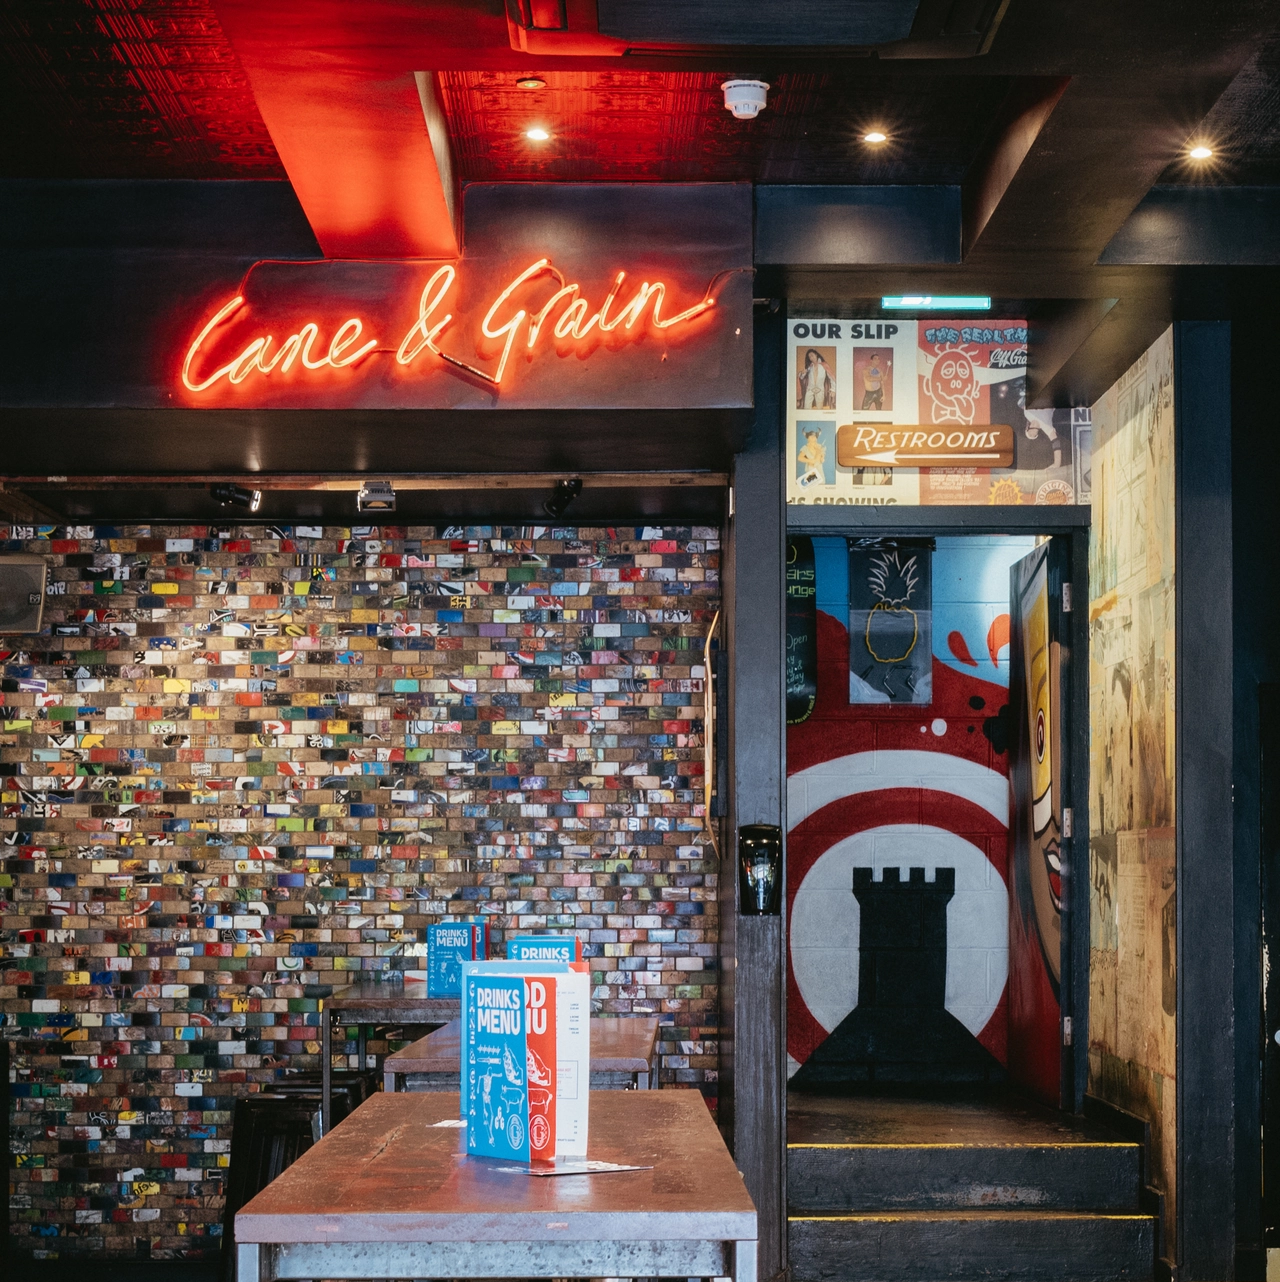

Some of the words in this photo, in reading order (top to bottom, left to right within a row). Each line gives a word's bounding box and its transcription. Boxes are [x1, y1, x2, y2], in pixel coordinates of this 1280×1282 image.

[181, 295, 378, 392] Cane
[396, 264, 454, 366] &
[481, 257, 715, 384] Grain
[792, 323, 842, 340] OUR
[850, 323, 899, 340] SLIP
[924, 326, 960, 345] THE
[960, 327, 1005, 345] REAL
[853, 426, 1001, 452] RESTROOMS
[436, 929, 469, 938] DRINKS
[436, 937, 469, 947] MENU
[521, 947, 570, 960] DRINKS
[477, 987, 521, 1010] DRINKS
[477, 1008, 521, 1036] MENU
